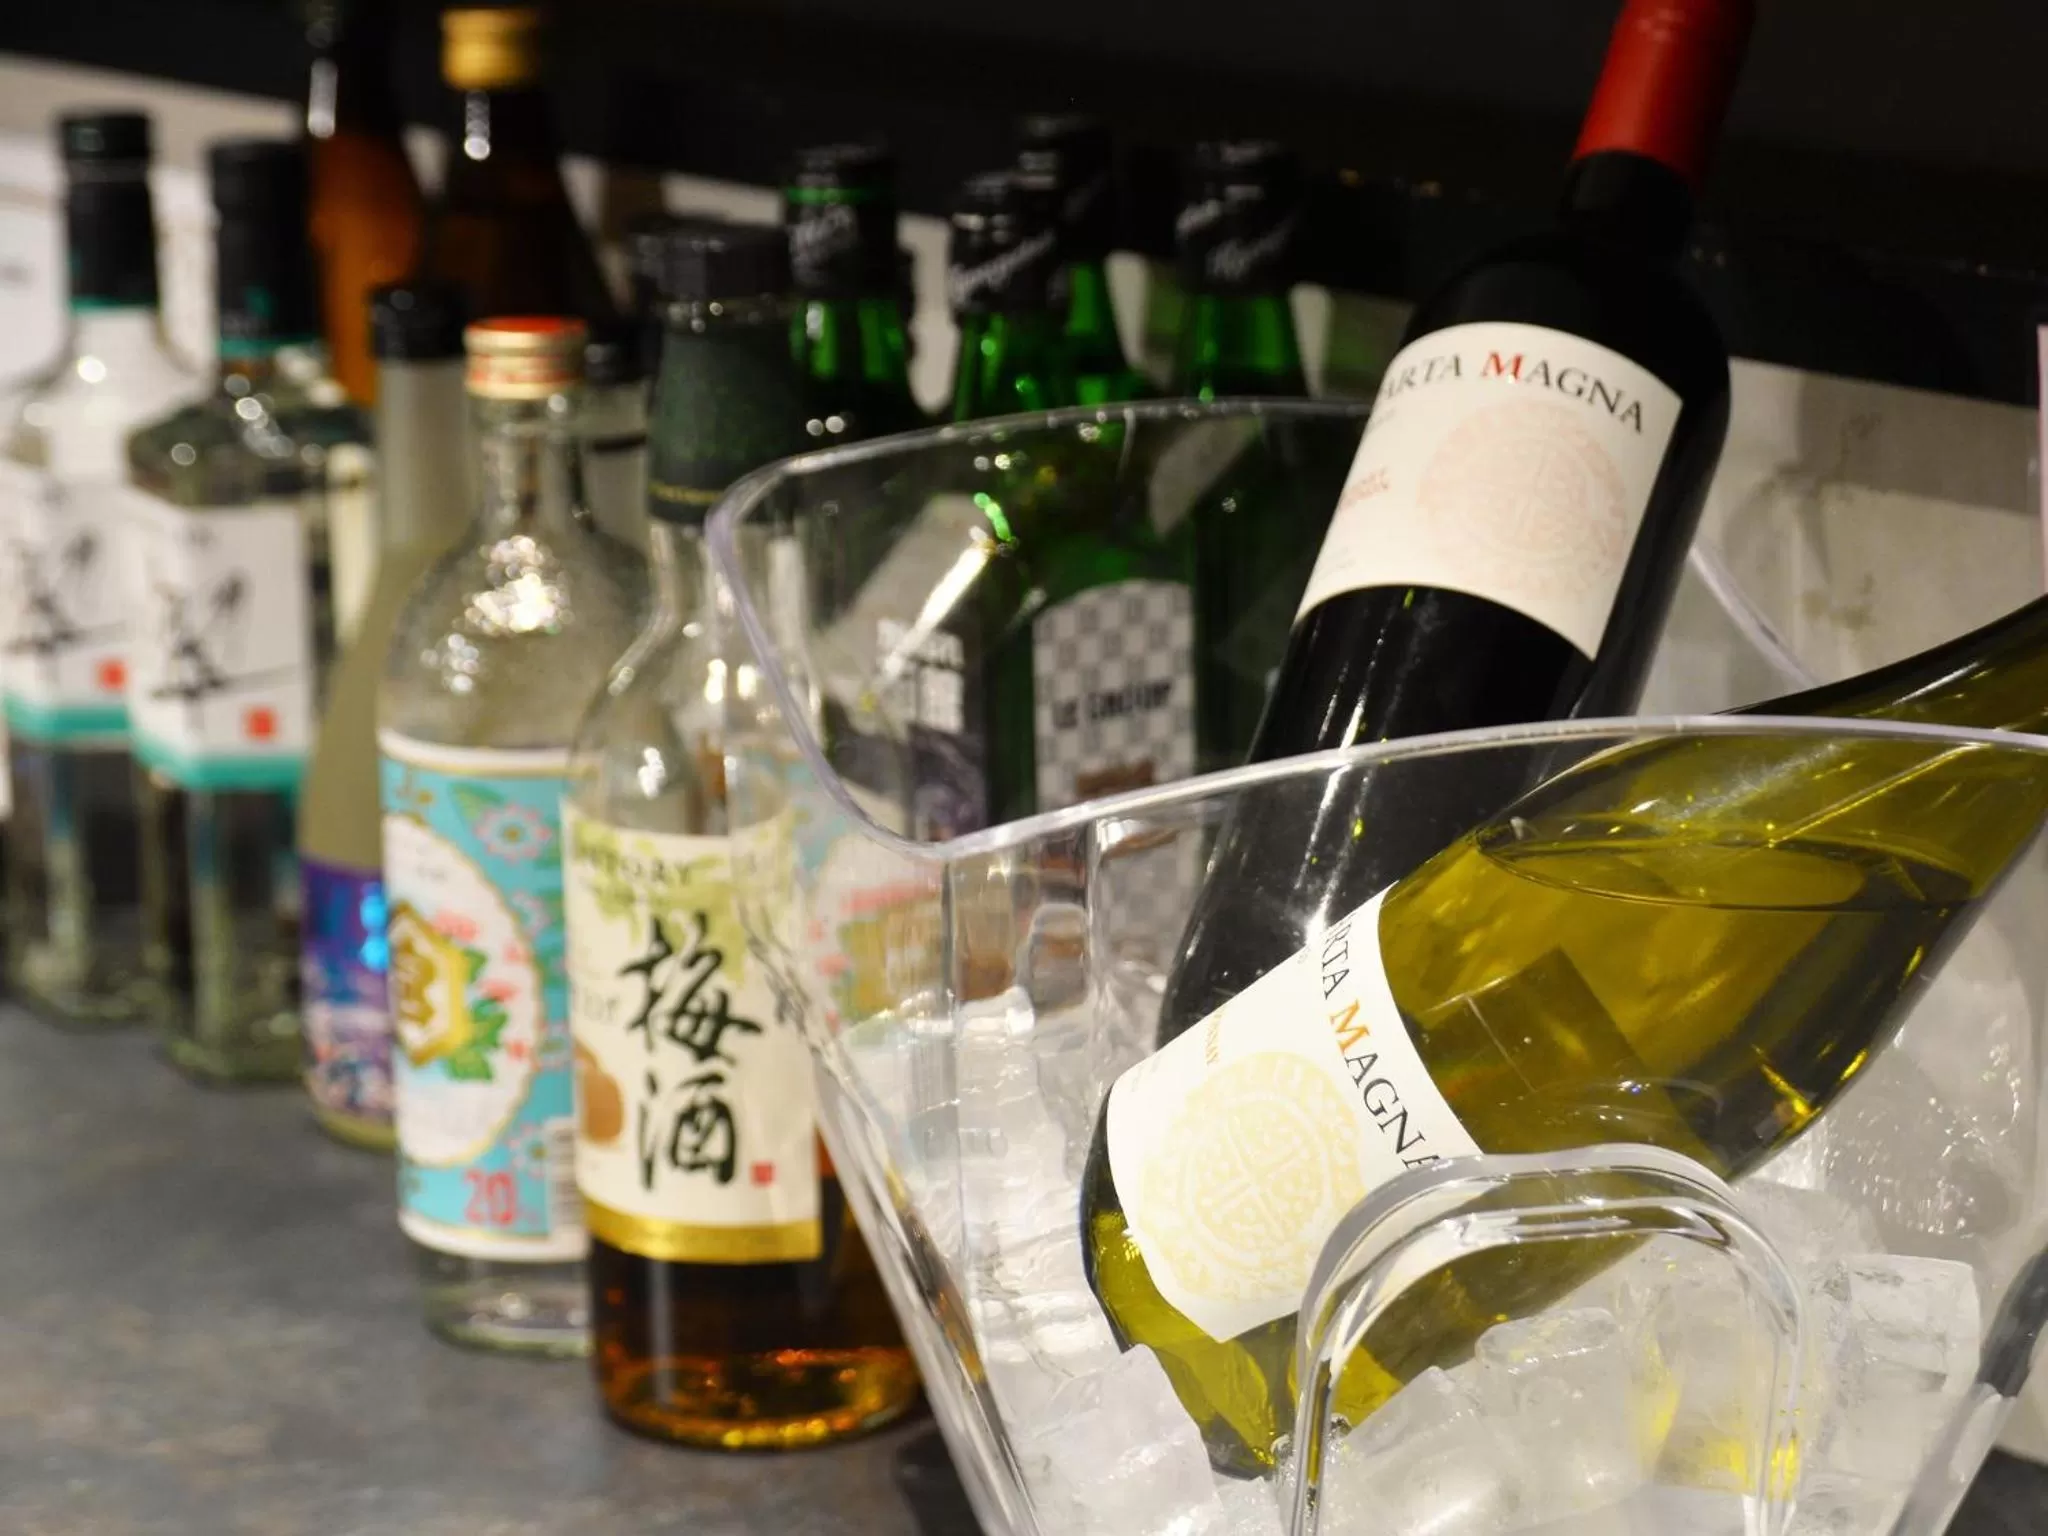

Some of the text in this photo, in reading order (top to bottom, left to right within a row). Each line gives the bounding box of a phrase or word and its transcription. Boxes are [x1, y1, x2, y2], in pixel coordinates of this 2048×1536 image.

[1479, 350, 1642, 434] MAGNA
[617, 908, 763, 1193] 梅酒
[463, 1168, 517, 1227] 20
